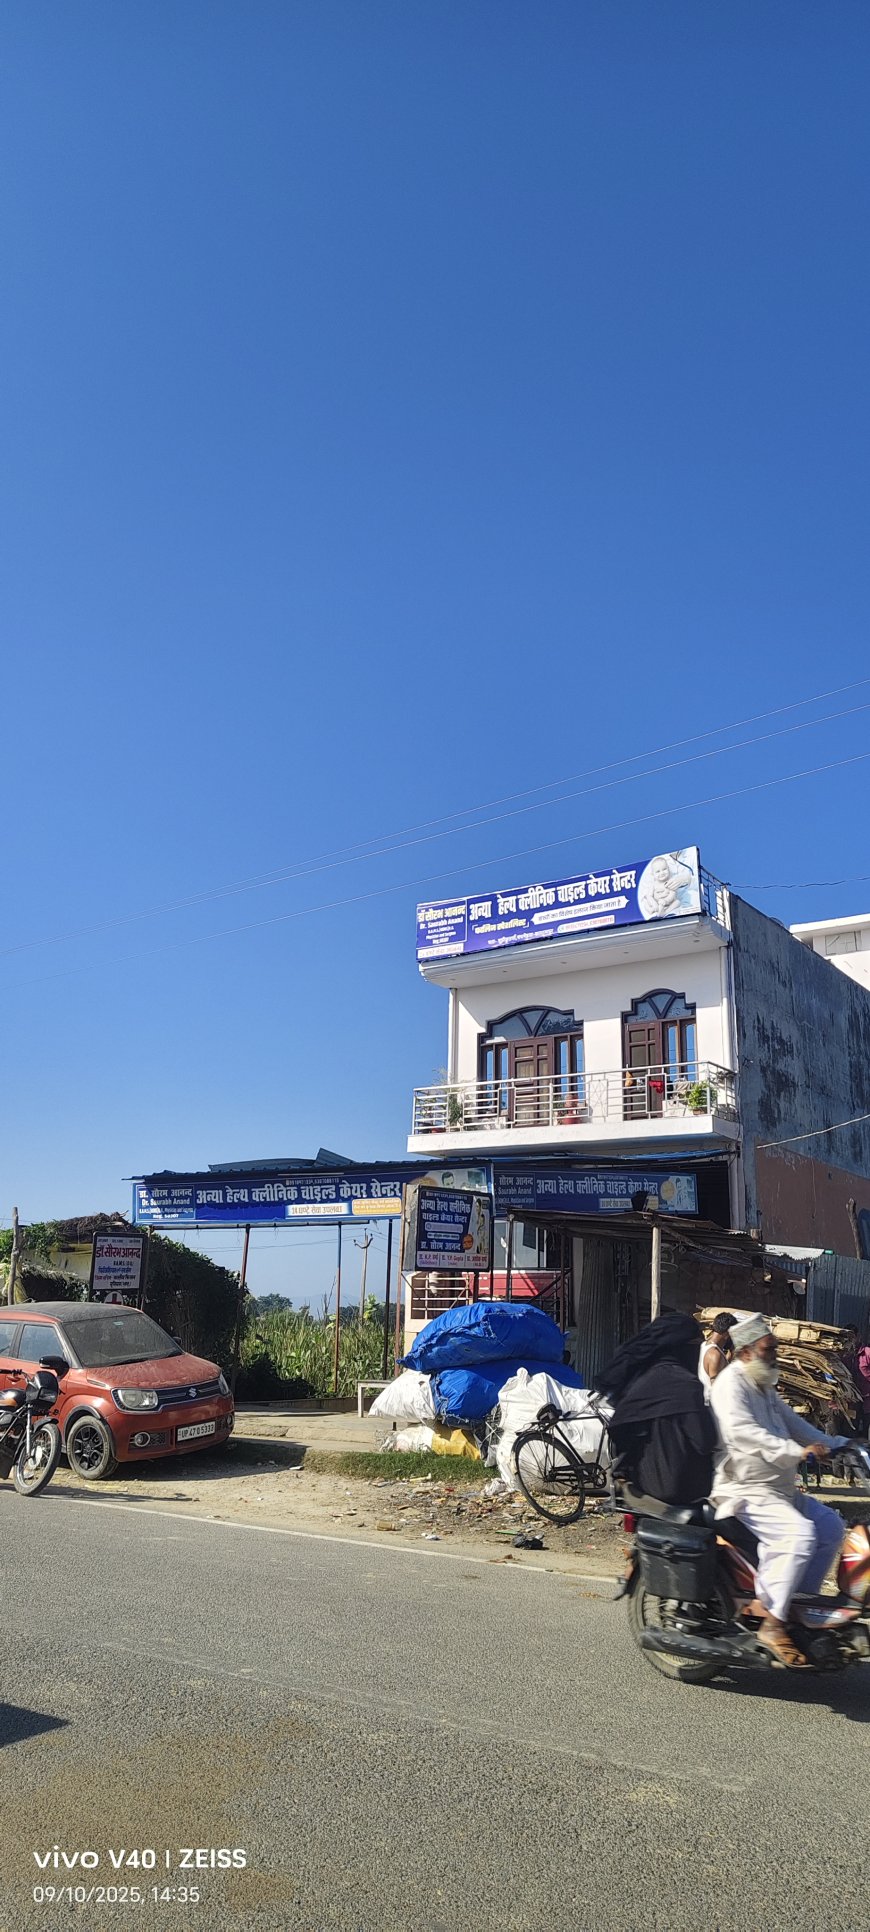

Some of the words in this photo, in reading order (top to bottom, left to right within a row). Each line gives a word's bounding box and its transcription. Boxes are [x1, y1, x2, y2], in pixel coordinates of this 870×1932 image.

[470, 901, 492, 920] अन्या
[518, 886, 556, 911] क्लीनिक
[557, 881, 586, 903] चाइल्ड
[587, 874, 611, 896] केयर
[611, 869, 637, 892] सेन्टर
[196, 1189, 223, 1204] अन्या
[224, 1185, 249, 1203] हेल्थ
[251, 1183, 298, 1202] क्लीनिक
[300, 1184, 336, 1202] चाइल्ड
[339, 1180, 368, 1198] केयर
[370, 1178, 402, 1198] सेन्टर
[536, 1179, 557, 1194] अन्या
[559, 1175, 575, 1194] हेल्थ
[576, 1176, 606, 1194] क्लीनिक
[606, 1180, 627, 1195] चाइल्ड
[170, 1188, 193, 1198] आनन्द
[150, 1198, 172, 1206] Saurabh
[172, 1197, 191, 1205] Anand
[420, 1199, 436, 1211] अन्या
[121, 1247, 141, 1259] आनन्द
